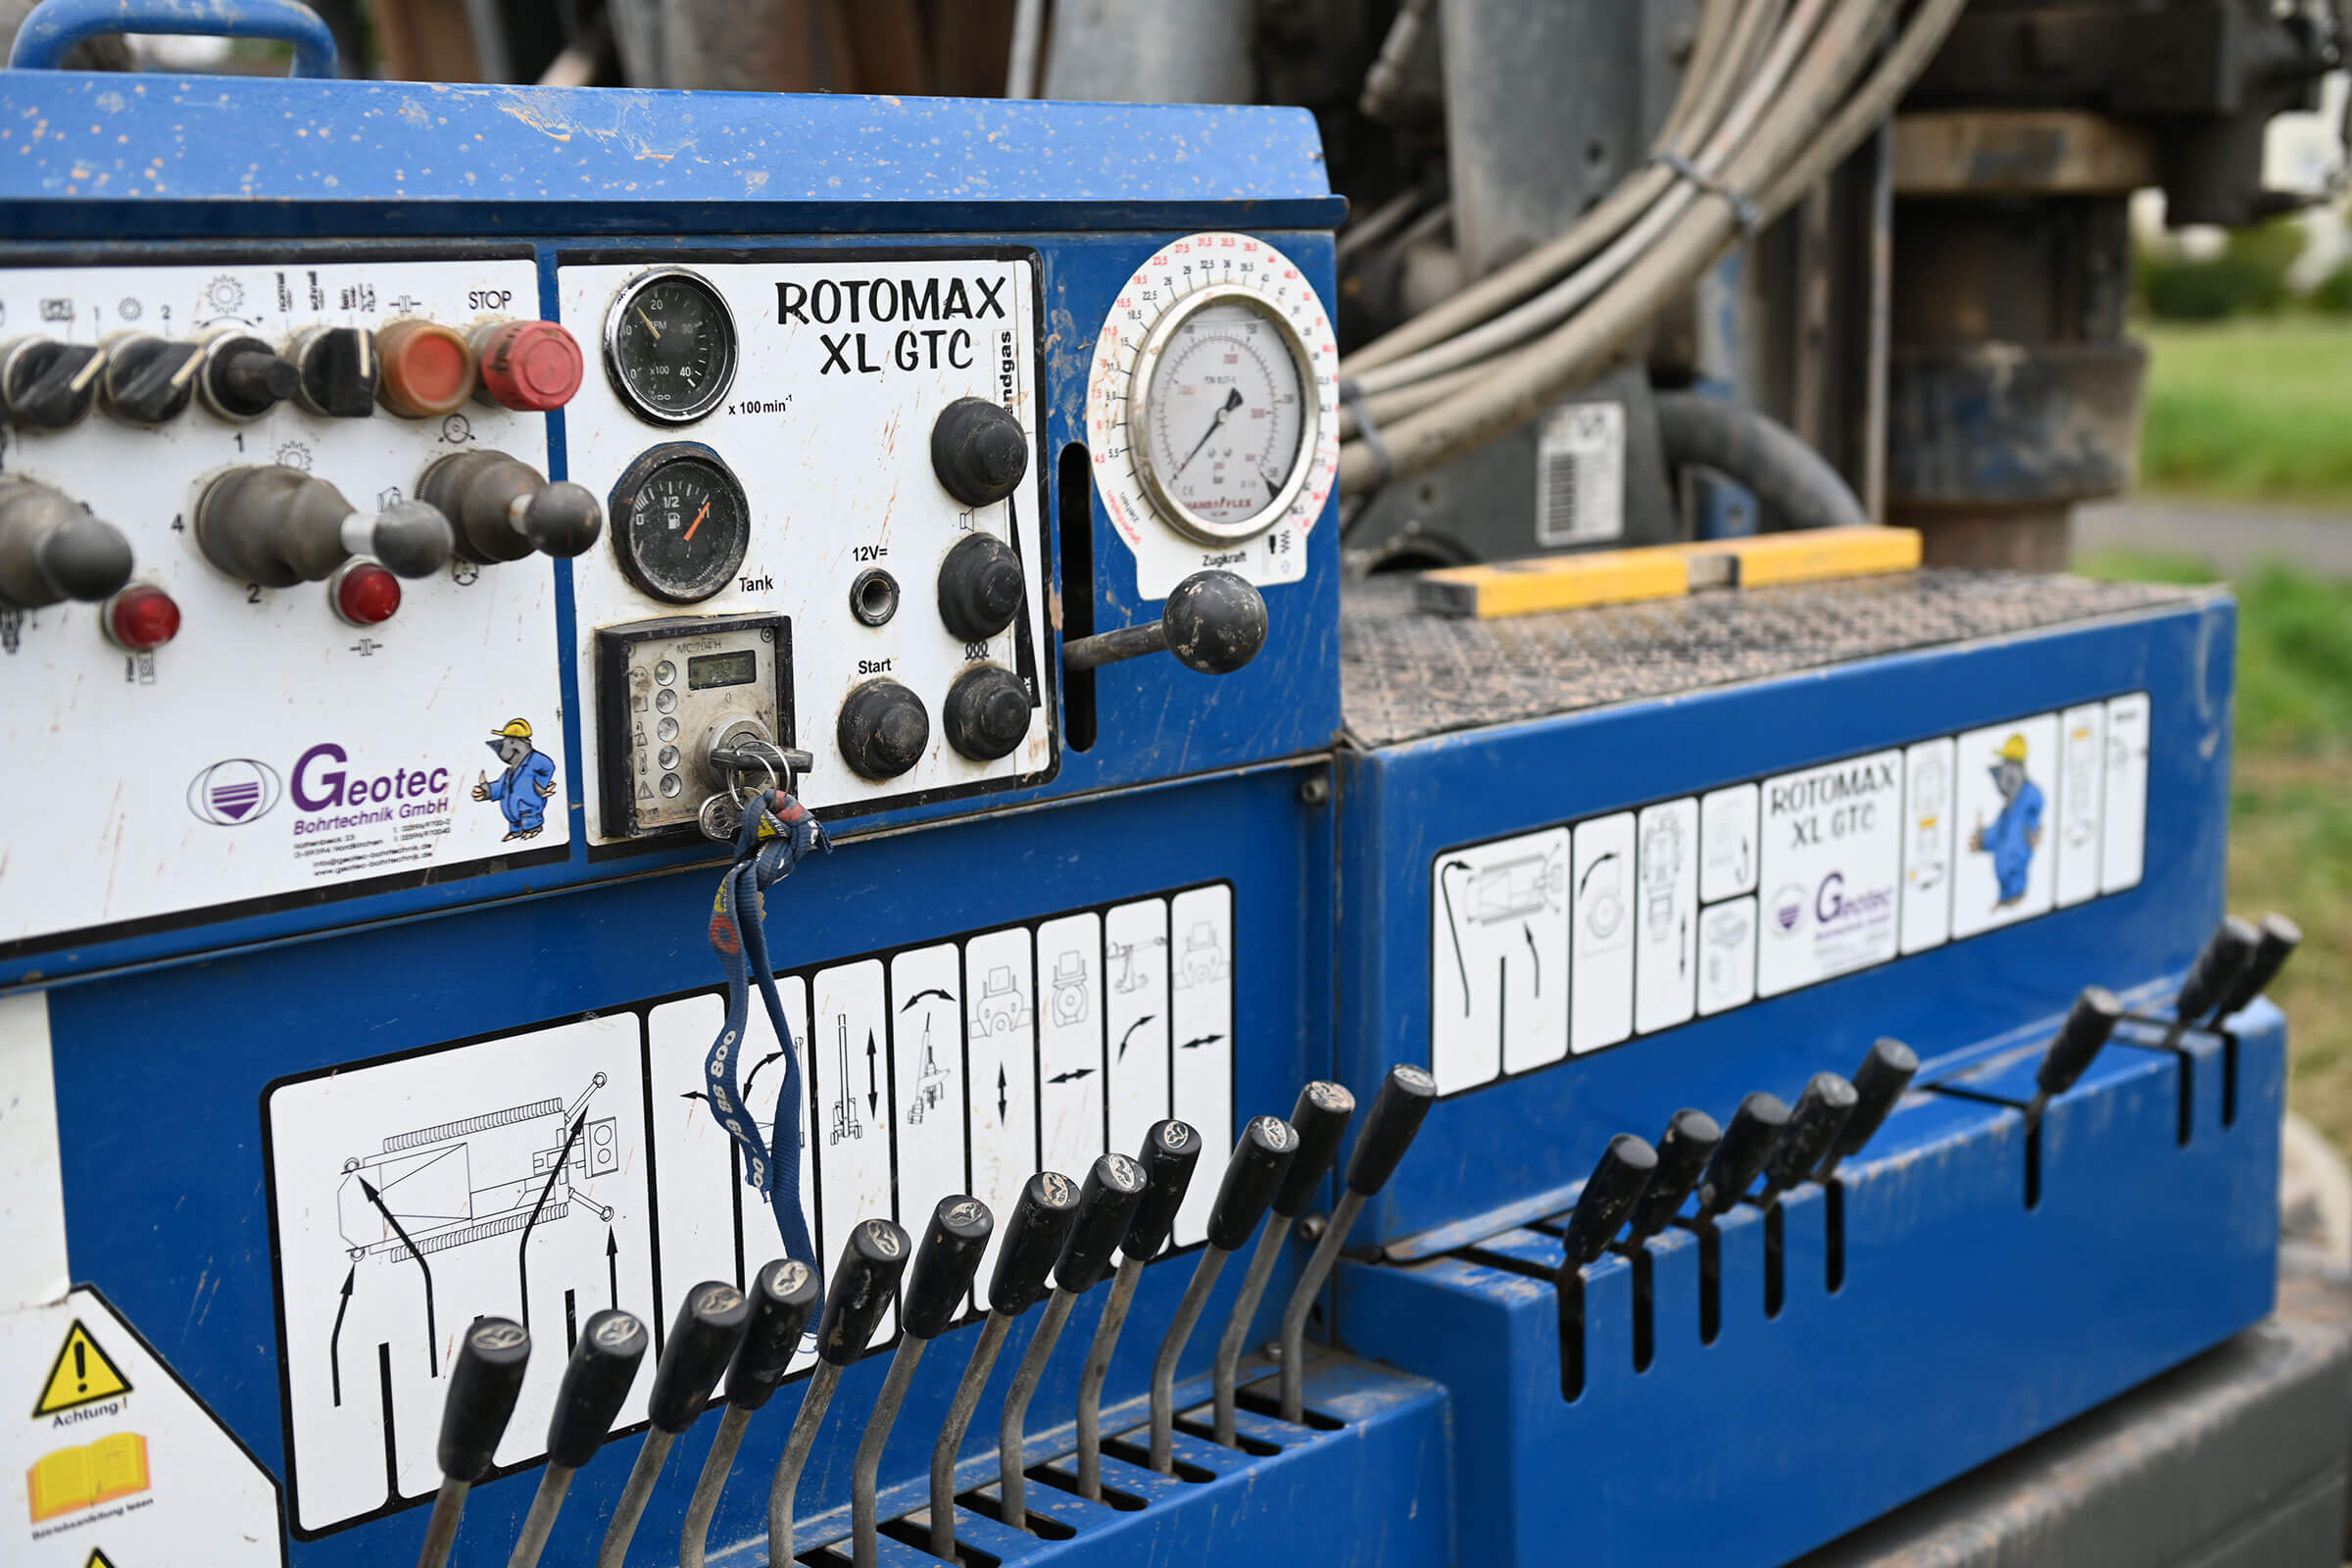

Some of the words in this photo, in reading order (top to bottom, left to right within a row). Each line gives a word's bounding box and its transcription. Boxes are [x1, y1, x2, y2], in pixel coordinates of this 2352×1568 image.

[468, 290, 512, 310] STOP
[651, 299, 663, 310] 20
[775, 275, 1007, 325] ROTOMAX
[161, 304, 171, 319] 2
[681, 323, 693, 334] 30
[820, 333, 881, 375] XL
[895, 328, 974, 371] GTC
[630, 368, 637, 379] 0
[679, 367, 691, 377] 40
[1000, 331, 1014, 416] andgas
[728, 405, 736, 416] x
[740, 401, 761, 415] 100
[233, 434, 244, 452] 1
[662, 496, 680, 509] 1/2
[172, 513, 184, 532] 4
[635, 514, 644, 525] 0
[853, 546, 888, 563] 12V=
[1202, 552, 1247, 567] Zugkraft
[739, 574, 773, 593] Tank
[247, 583, 261, 604] 2
[858, 659, 892, 675] Start
[290, 742, 449, 813] Geotec
[1771, 763, 1893, 815] ROTOMAX
[294, 808, 393, 835] Bohrtechnik
[399, 798, 449, 819] GmbH
[1791, 817, 1822, 850] XL
[1832, 802, 1877, 840] GTC
[314, 851, 433, 876] www.geotec-bohrtechnik.de
[710, 1030, 736, 1078] 800
[52, 1400, 119, 1428] Achtung
[32, 1507, 123, 1541] Betriebsanleitung
